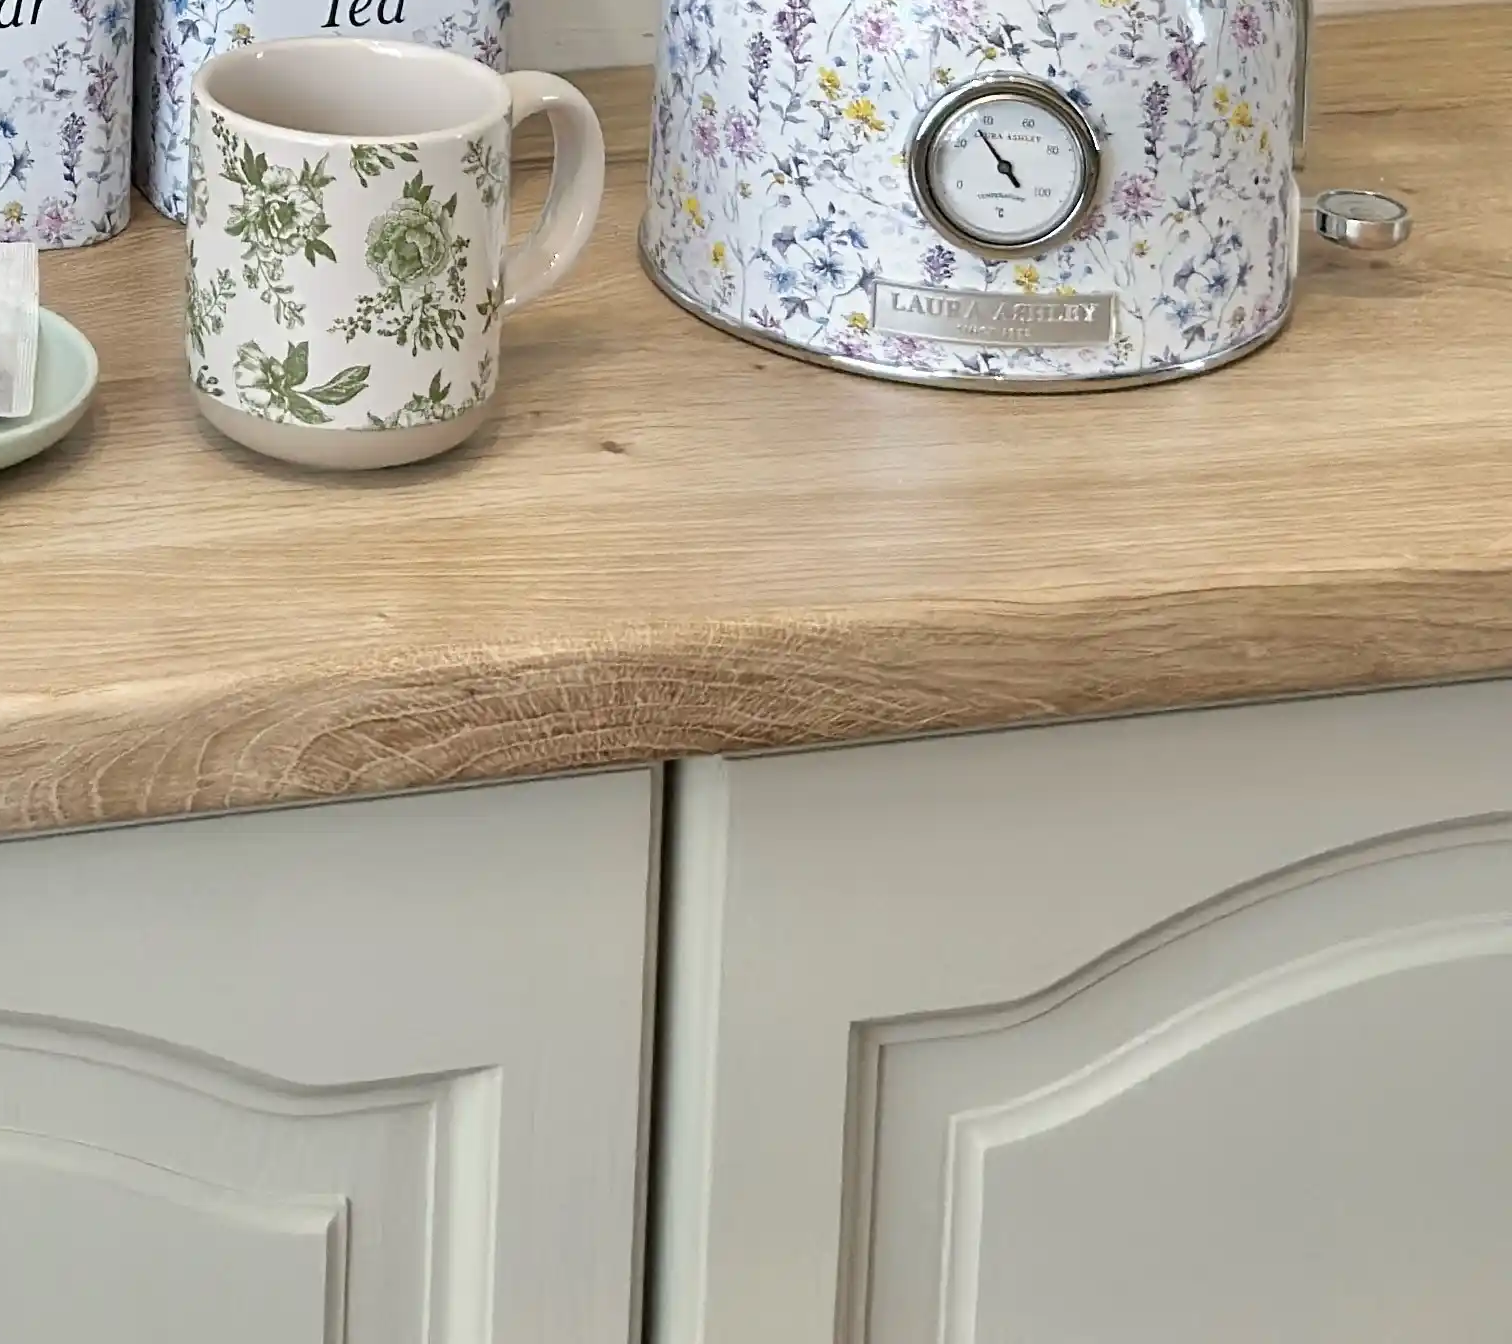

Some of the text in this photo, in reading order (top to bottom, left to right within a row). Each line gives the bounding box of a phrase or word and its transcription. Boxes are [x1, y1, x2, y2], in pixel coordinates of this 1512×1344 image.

[1022, 118, 1035, 128] 60
[954, 138, 968, 149] 20
[1046, 145, 1059, 155] 80
[956, 180, 964, 189] 0
[1034, 187, 1052, 198] 100
[890, 291, 1099, 323] LAURA ASHLEY
